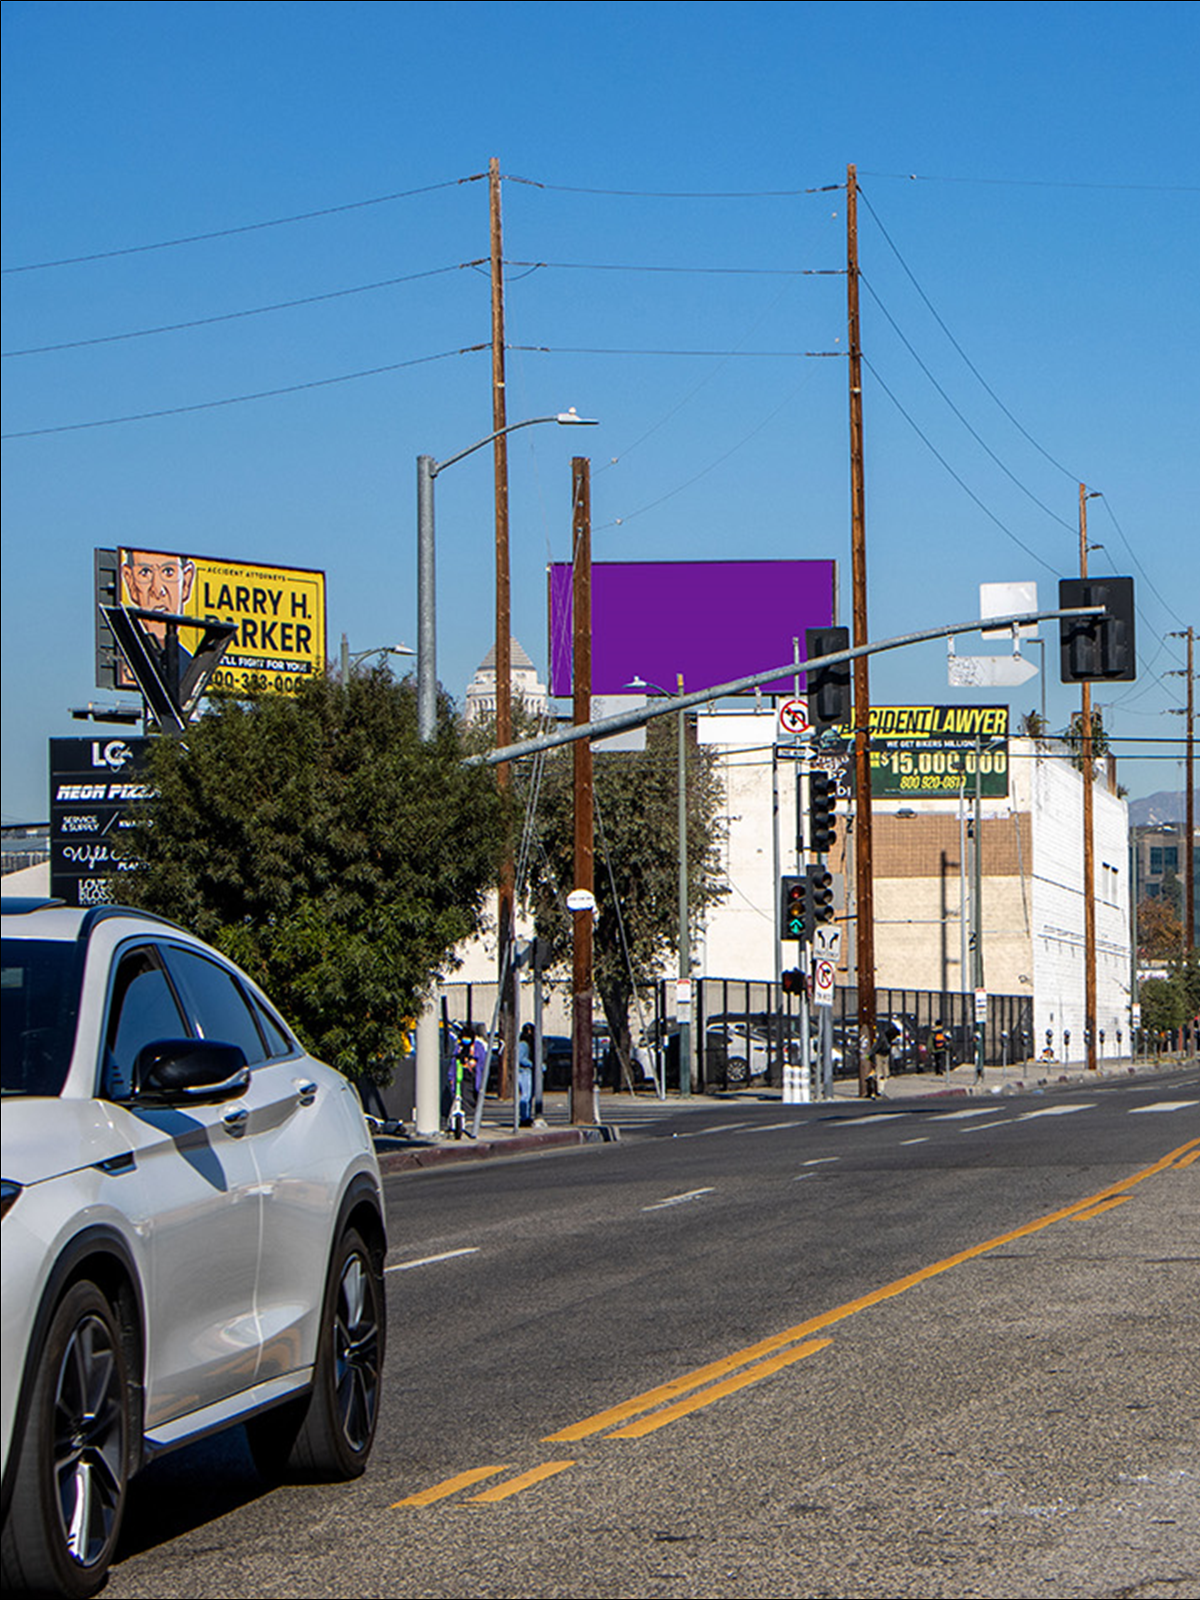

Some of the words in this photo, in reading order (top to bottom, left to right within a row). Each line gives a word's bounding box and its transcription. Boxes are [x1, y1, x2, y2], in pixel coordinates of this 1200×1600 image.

[207, 567, 244, 577] ACCIDENT
[246, 570, 287, 582] ATTORNEYS
[204, 582, 283, 615] LARRY
[291, 592, 312, 619] H.
[204, 615, 312, 653] ARKER
[238, 656, 264, 668] FIGHT
[266, 659, 284, 671] FOR
[840, 709, 932, 735] CIDENT
[934, 709, 1007, 734] LAWYER
[944, 740, 976, 749] MILLION
[56, 784, 107, 800] NEON
